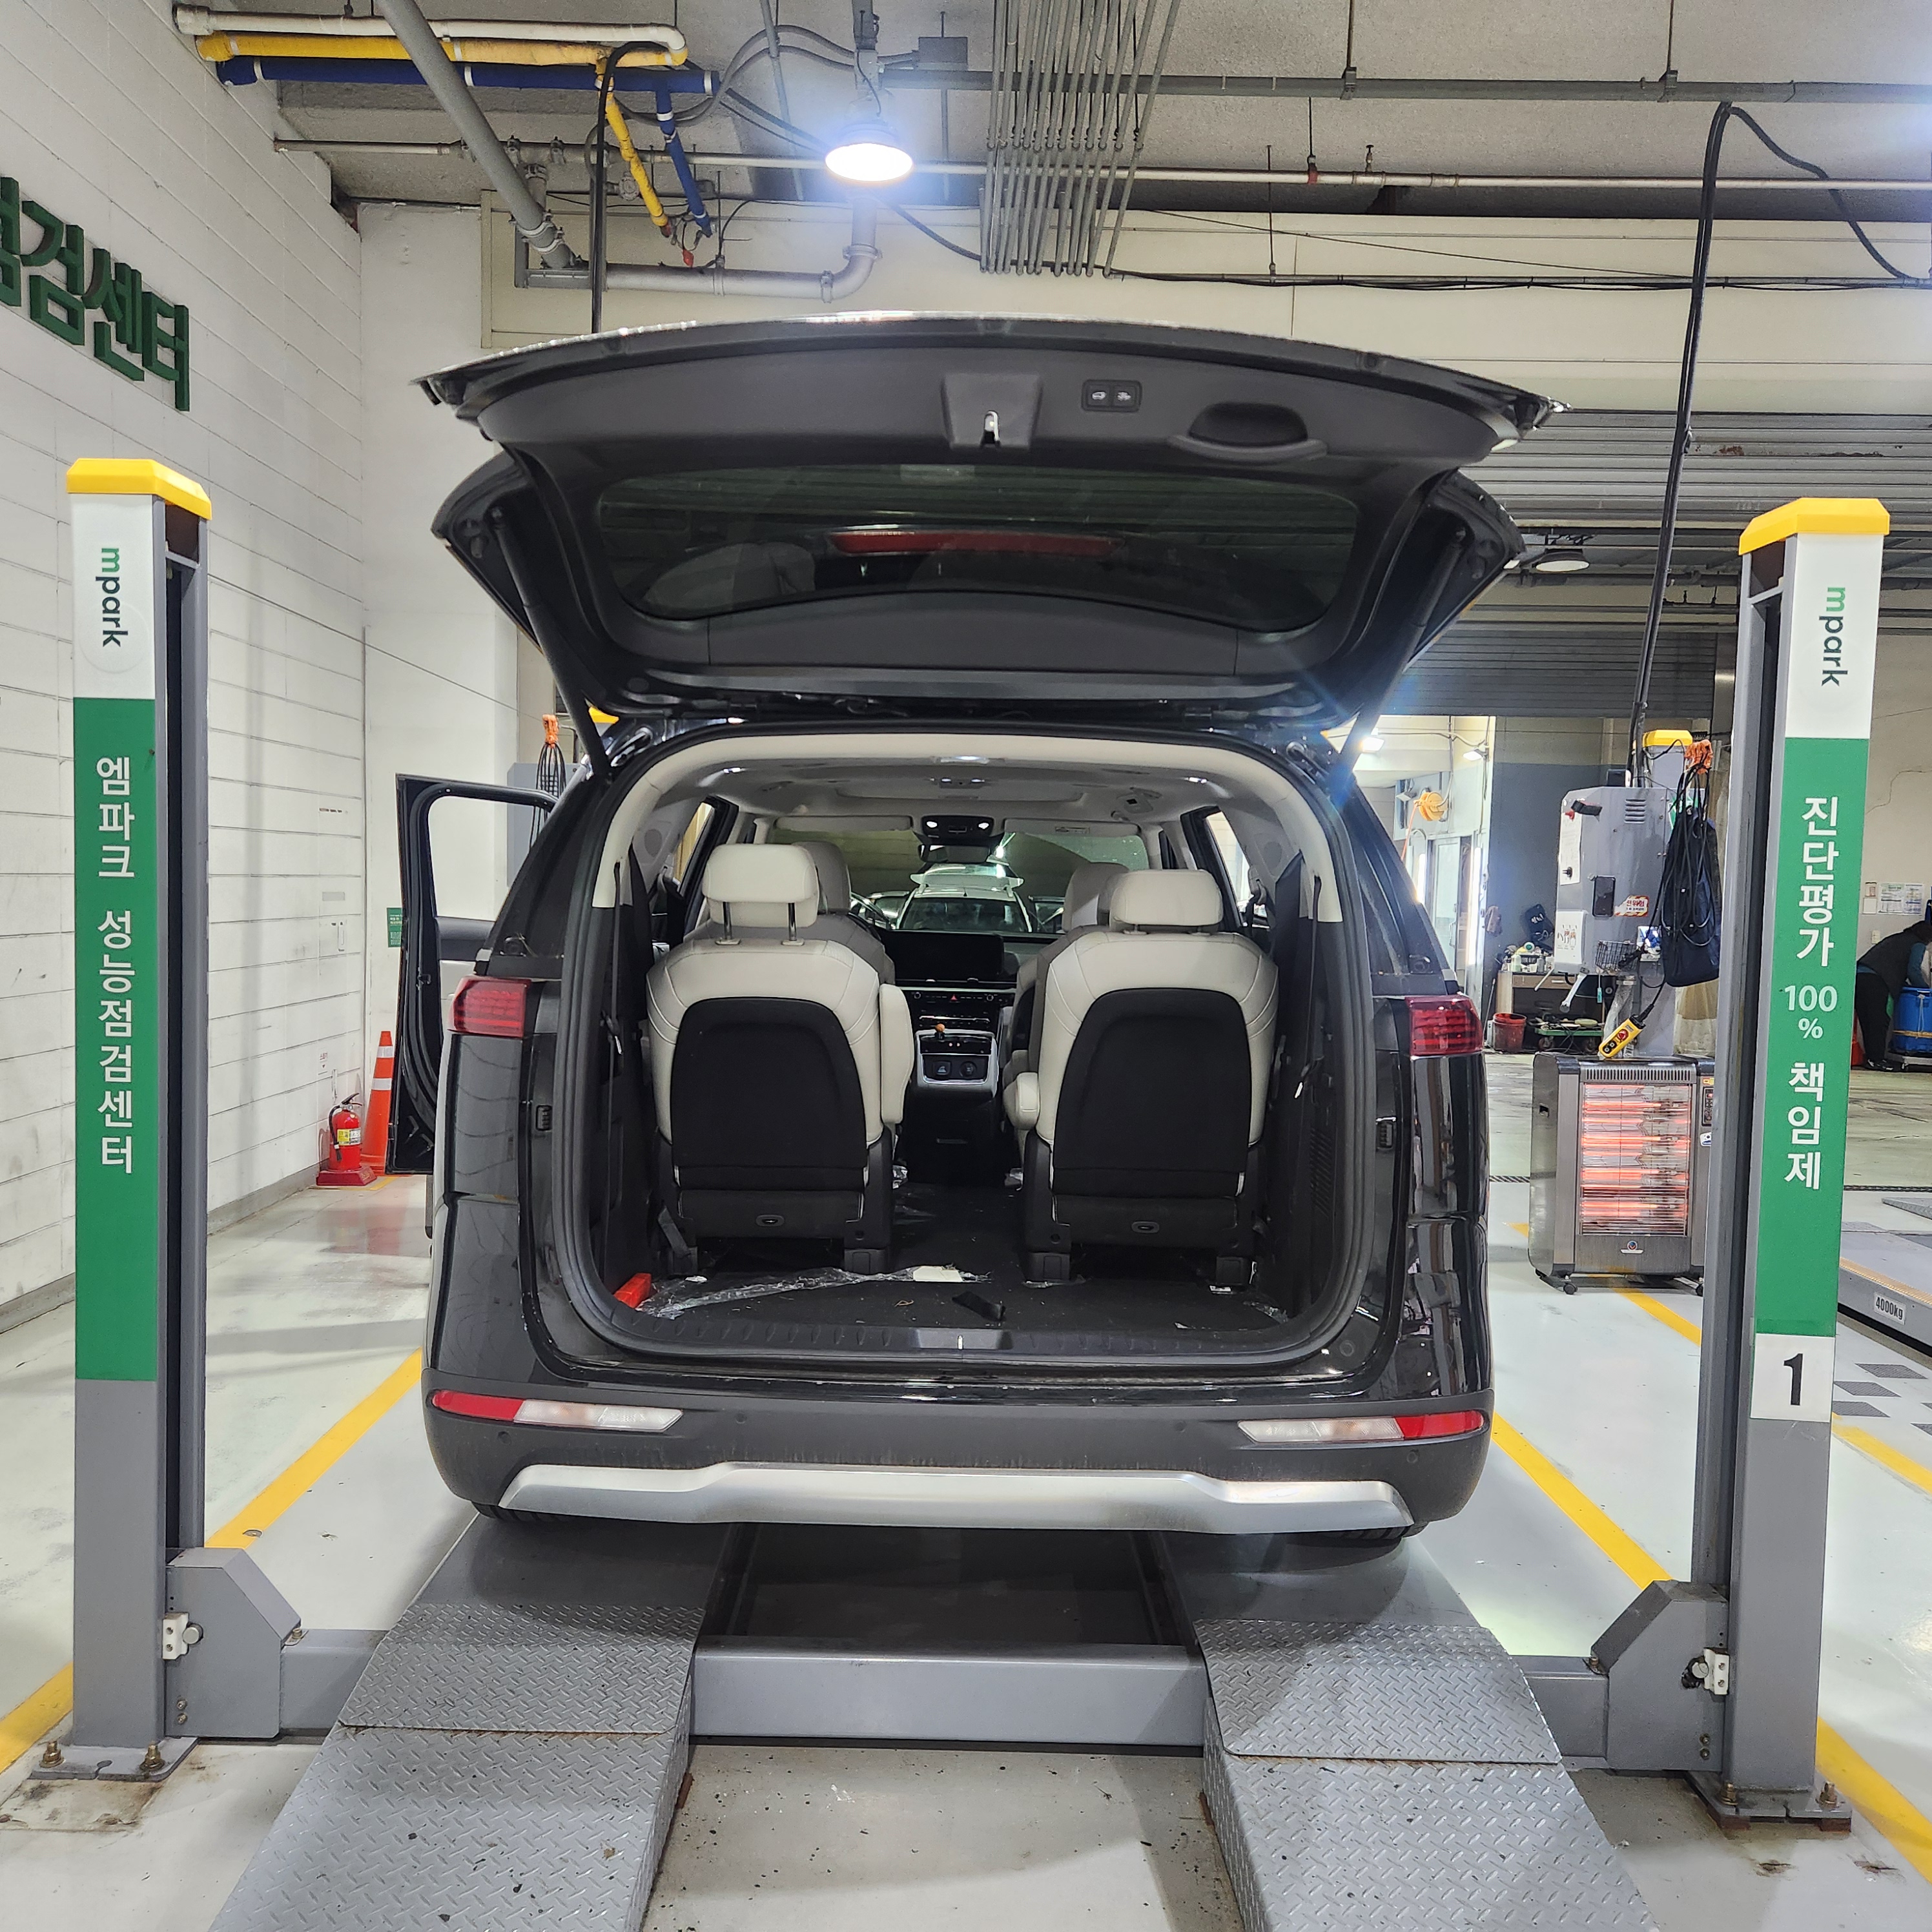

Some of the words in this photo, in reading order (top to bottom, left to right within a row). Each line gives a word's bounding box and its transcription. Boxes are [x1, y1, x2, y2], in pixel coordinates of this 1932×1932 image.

[96, 548, 128, 647] mpark
[1819, 587, 1848, 686] mpark
[97, 757, 135, 878] 엠파크
[1796, 796, 1840, 967] 진단평가
[98, 910, 135, 1174] 성능점검센터
[1784, 985, 1838, 1012] 100
[1784, 1062, 1825, 1190] 책임제
[1876, 1297, 1903, 1320] 4000kg
[1783, 1353, 1804, 1406] 1
